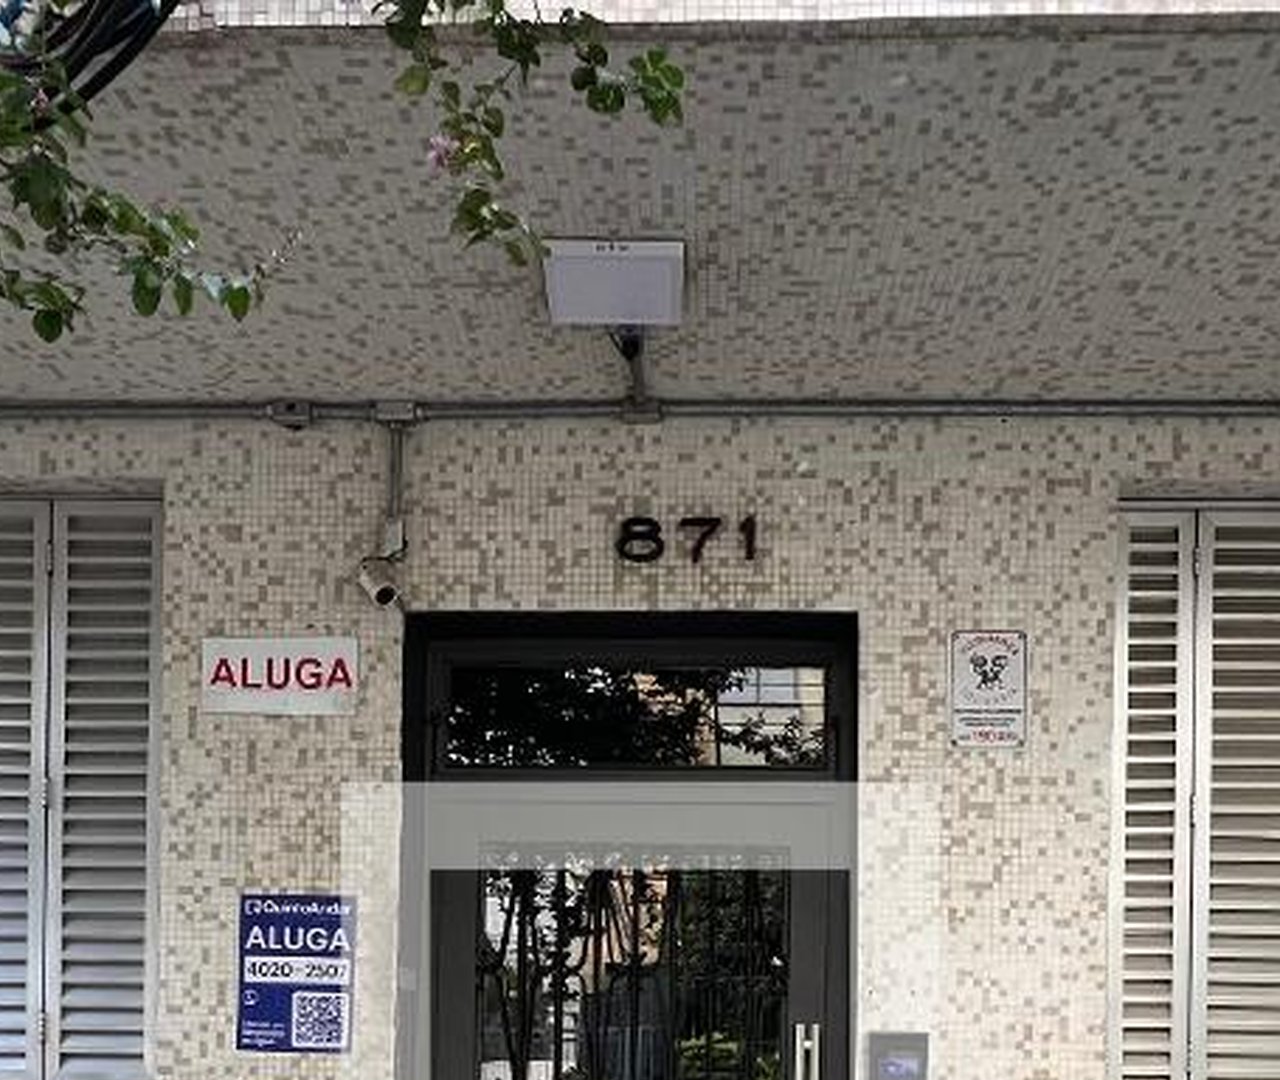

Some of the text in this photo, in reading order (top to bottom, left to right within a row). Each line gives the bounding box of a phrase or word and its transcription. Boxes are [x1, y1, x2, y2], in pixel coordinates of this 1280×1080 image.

[616, 517, 756, 563] 871
[210, 658, 352, 689] ALUGA
[245, 925, 351, 951] ALUGA
